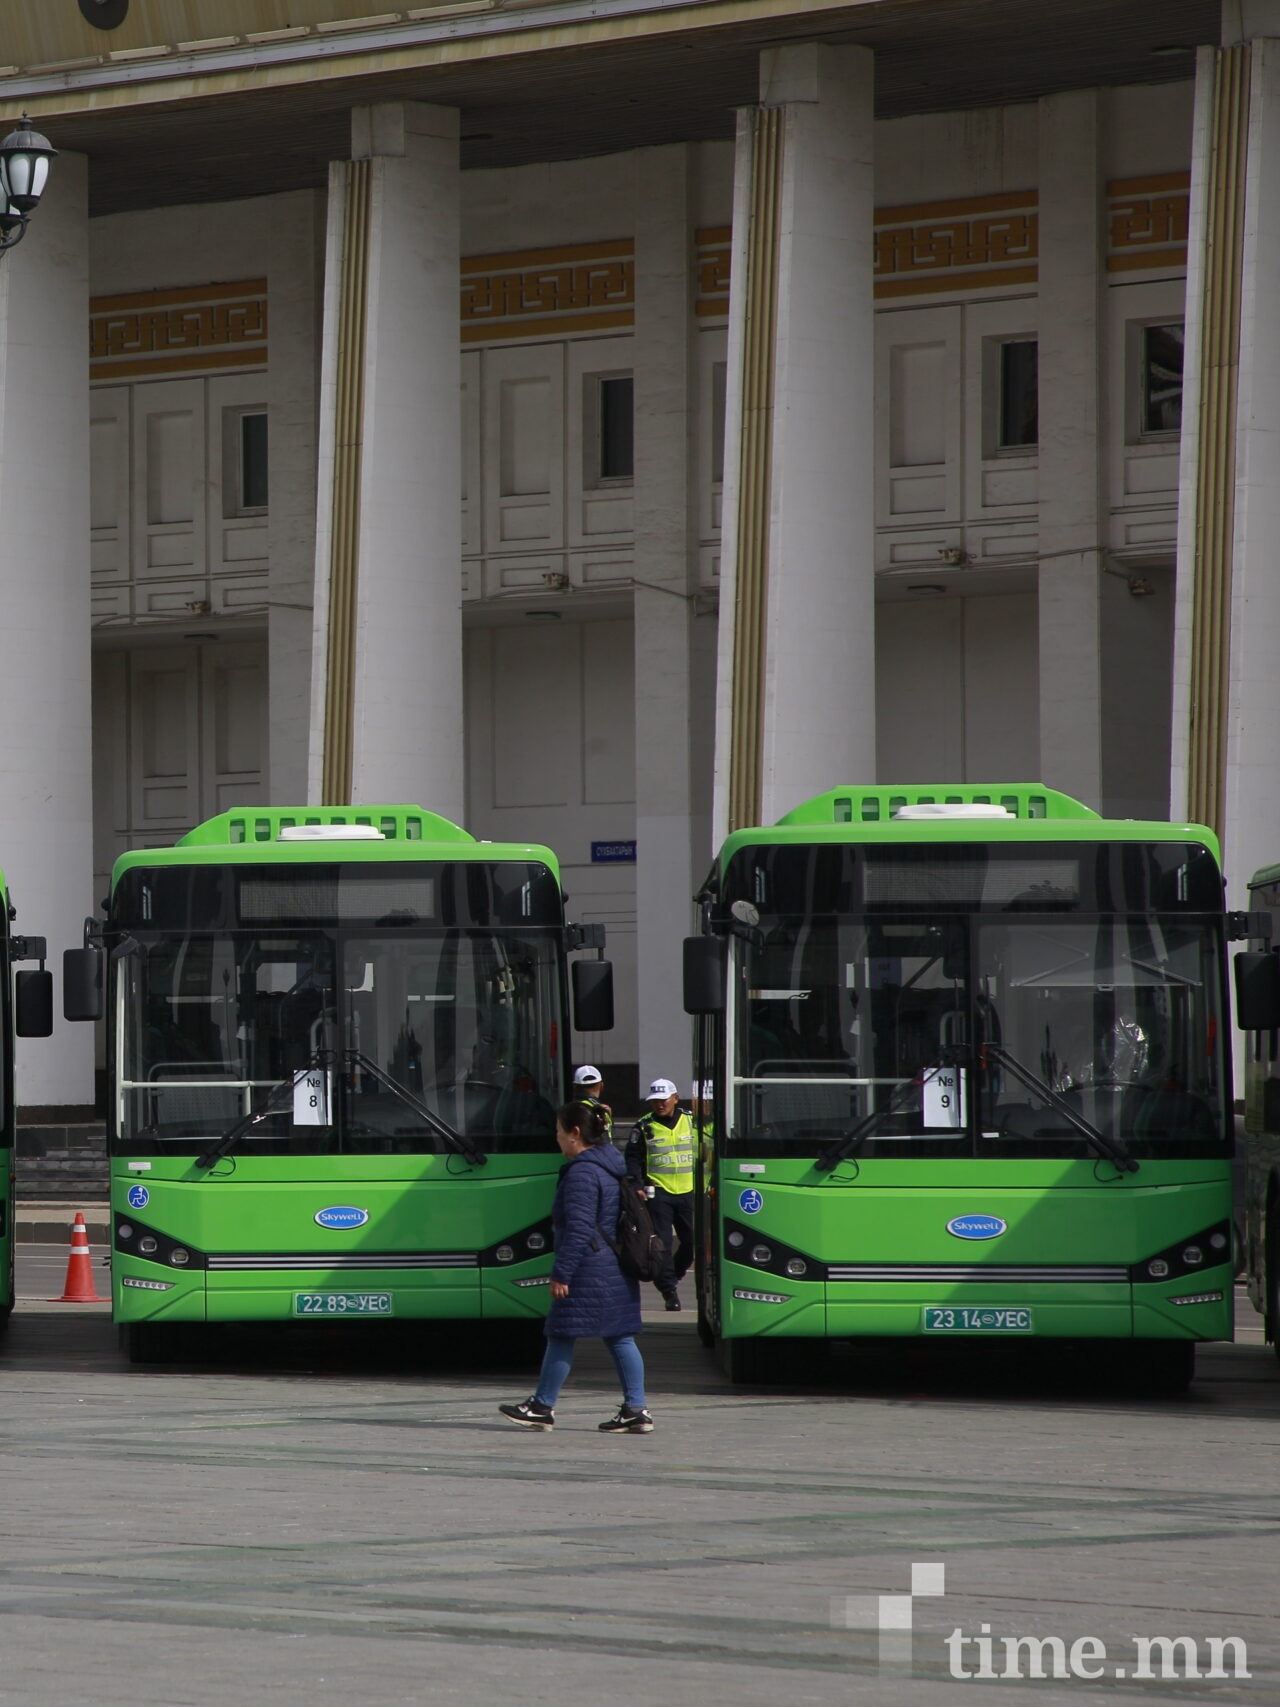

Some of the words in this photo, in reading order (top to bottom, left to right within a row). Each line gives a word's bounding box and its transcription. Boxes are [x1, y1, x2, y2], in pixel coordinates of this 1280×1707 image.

[306, 1077, 321, 1088] №
[938, 1075, 954, 1087] №
[309, 1095, 318, 1108] 8
[940, 1094, 951, 1109] 9
[320, 1212, 362, 1222] Skywell
[954, 1221, 1001, 1231] Skywell
